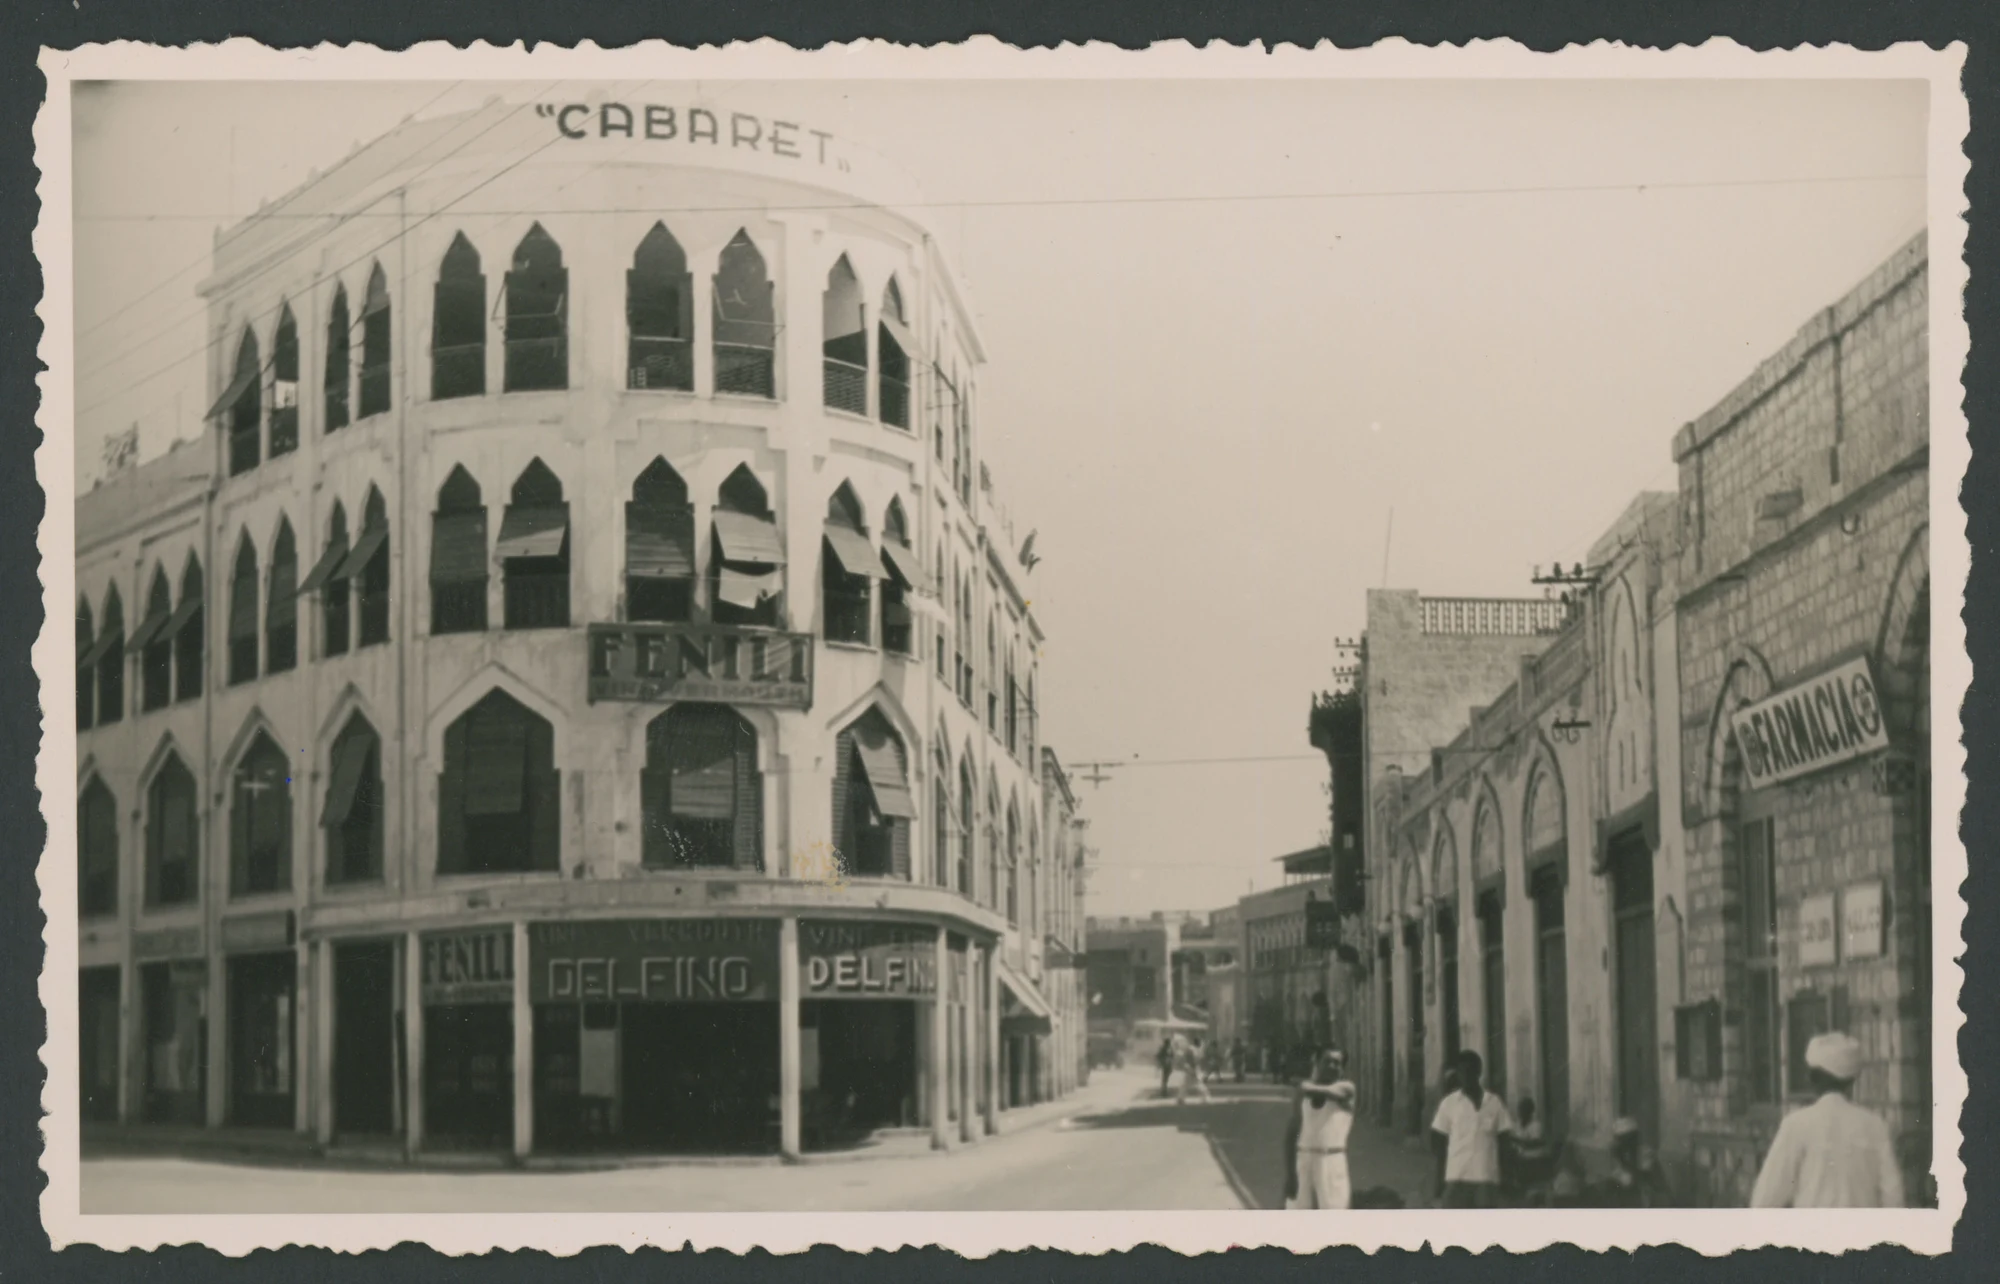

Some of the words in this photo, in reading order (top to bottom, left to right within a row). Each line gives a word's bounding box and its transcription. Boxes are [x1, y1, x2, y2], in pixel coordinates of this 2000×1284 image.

[591, 631, 807, 683] FENILI
[1751, 677, 1863, 775] FARMACIA
[549, 957, 750, 1000] DELFINO
